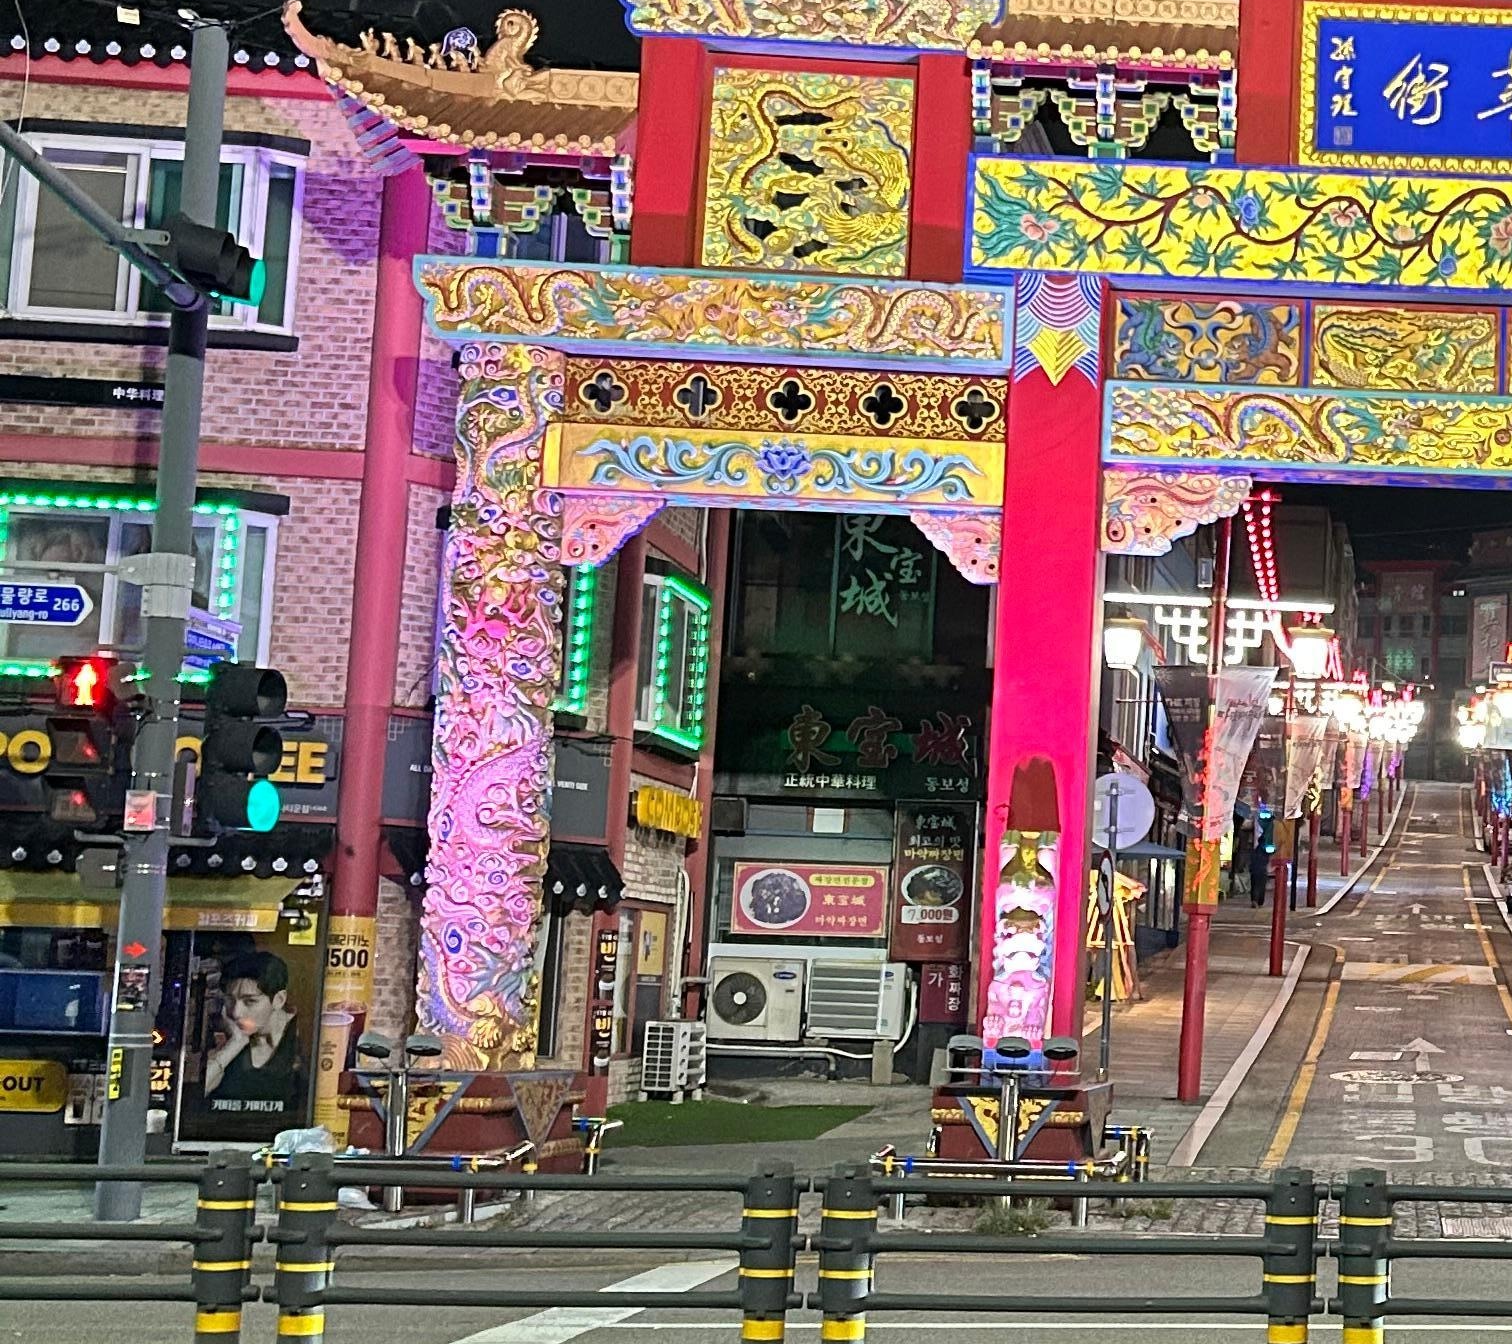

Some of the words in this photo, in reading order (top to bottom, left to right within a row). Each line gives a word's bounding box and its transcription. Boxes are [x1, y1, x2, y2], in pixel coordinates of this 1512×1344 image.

[53, 598, 80, 612] 266
[784, 773, 877, 790] 正統中華料理
[924, 776, 970, 793] 동보성
